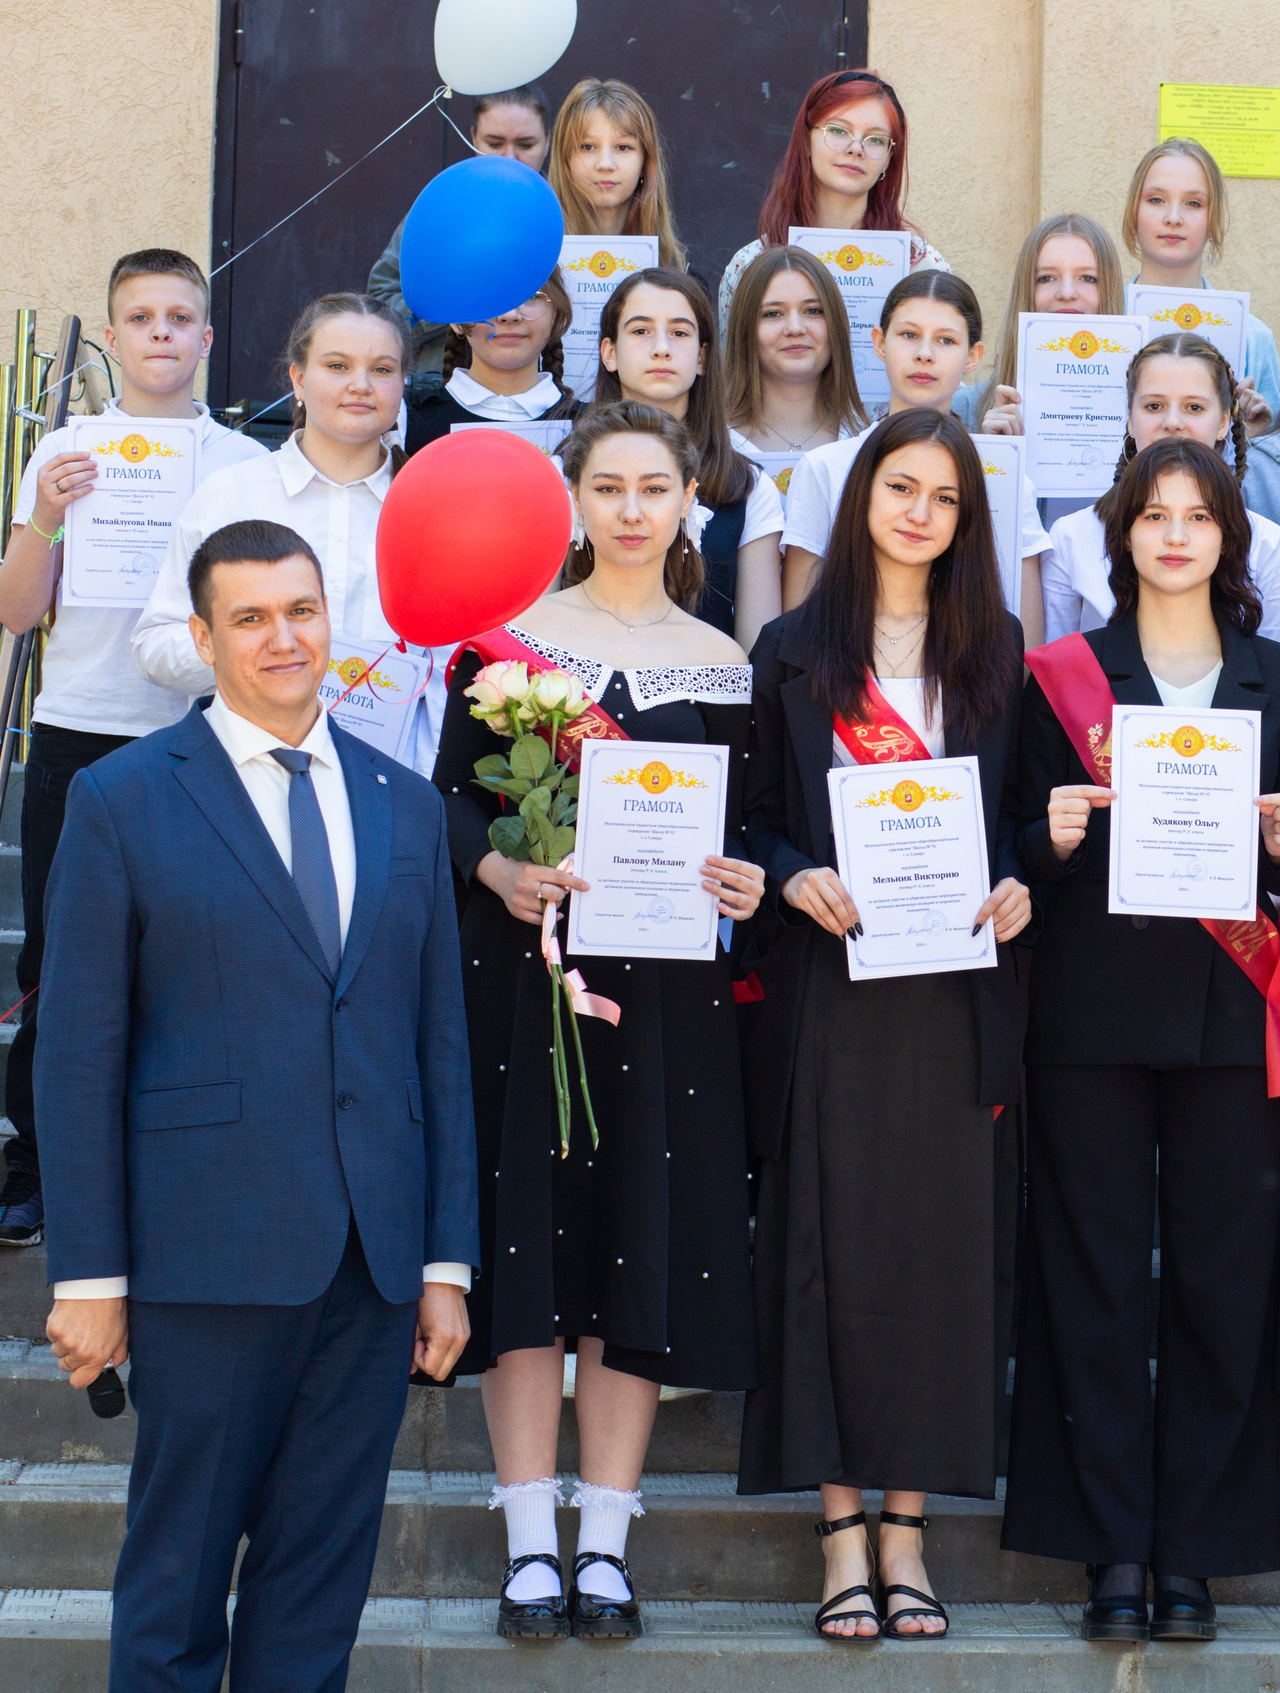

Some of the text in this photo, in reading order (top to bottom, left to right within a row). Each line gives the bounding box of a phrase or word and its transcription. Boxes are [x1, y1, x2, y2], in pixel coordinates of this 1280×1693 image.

[1056, 364, 1109, 375] ГРАМОТА
[1040, 412, 1122, 422] Дмитриеву Кристину
[106, 468, 161, 480] ГРАМОТА
[92, 518, 144, 527] Михайлусова
[1157, 762, 1217, 776] ГРАМОТА
[624, 799, 684, 813] ГРАМОТА
[880, 816, 941, 831] ГРАМОТА
[1152, 817, 1220, 829] Худякову Ольгу
[613, 856, 686, 868] Павлову Милану
[873, 871, 959, 884] Мельник Викторию
